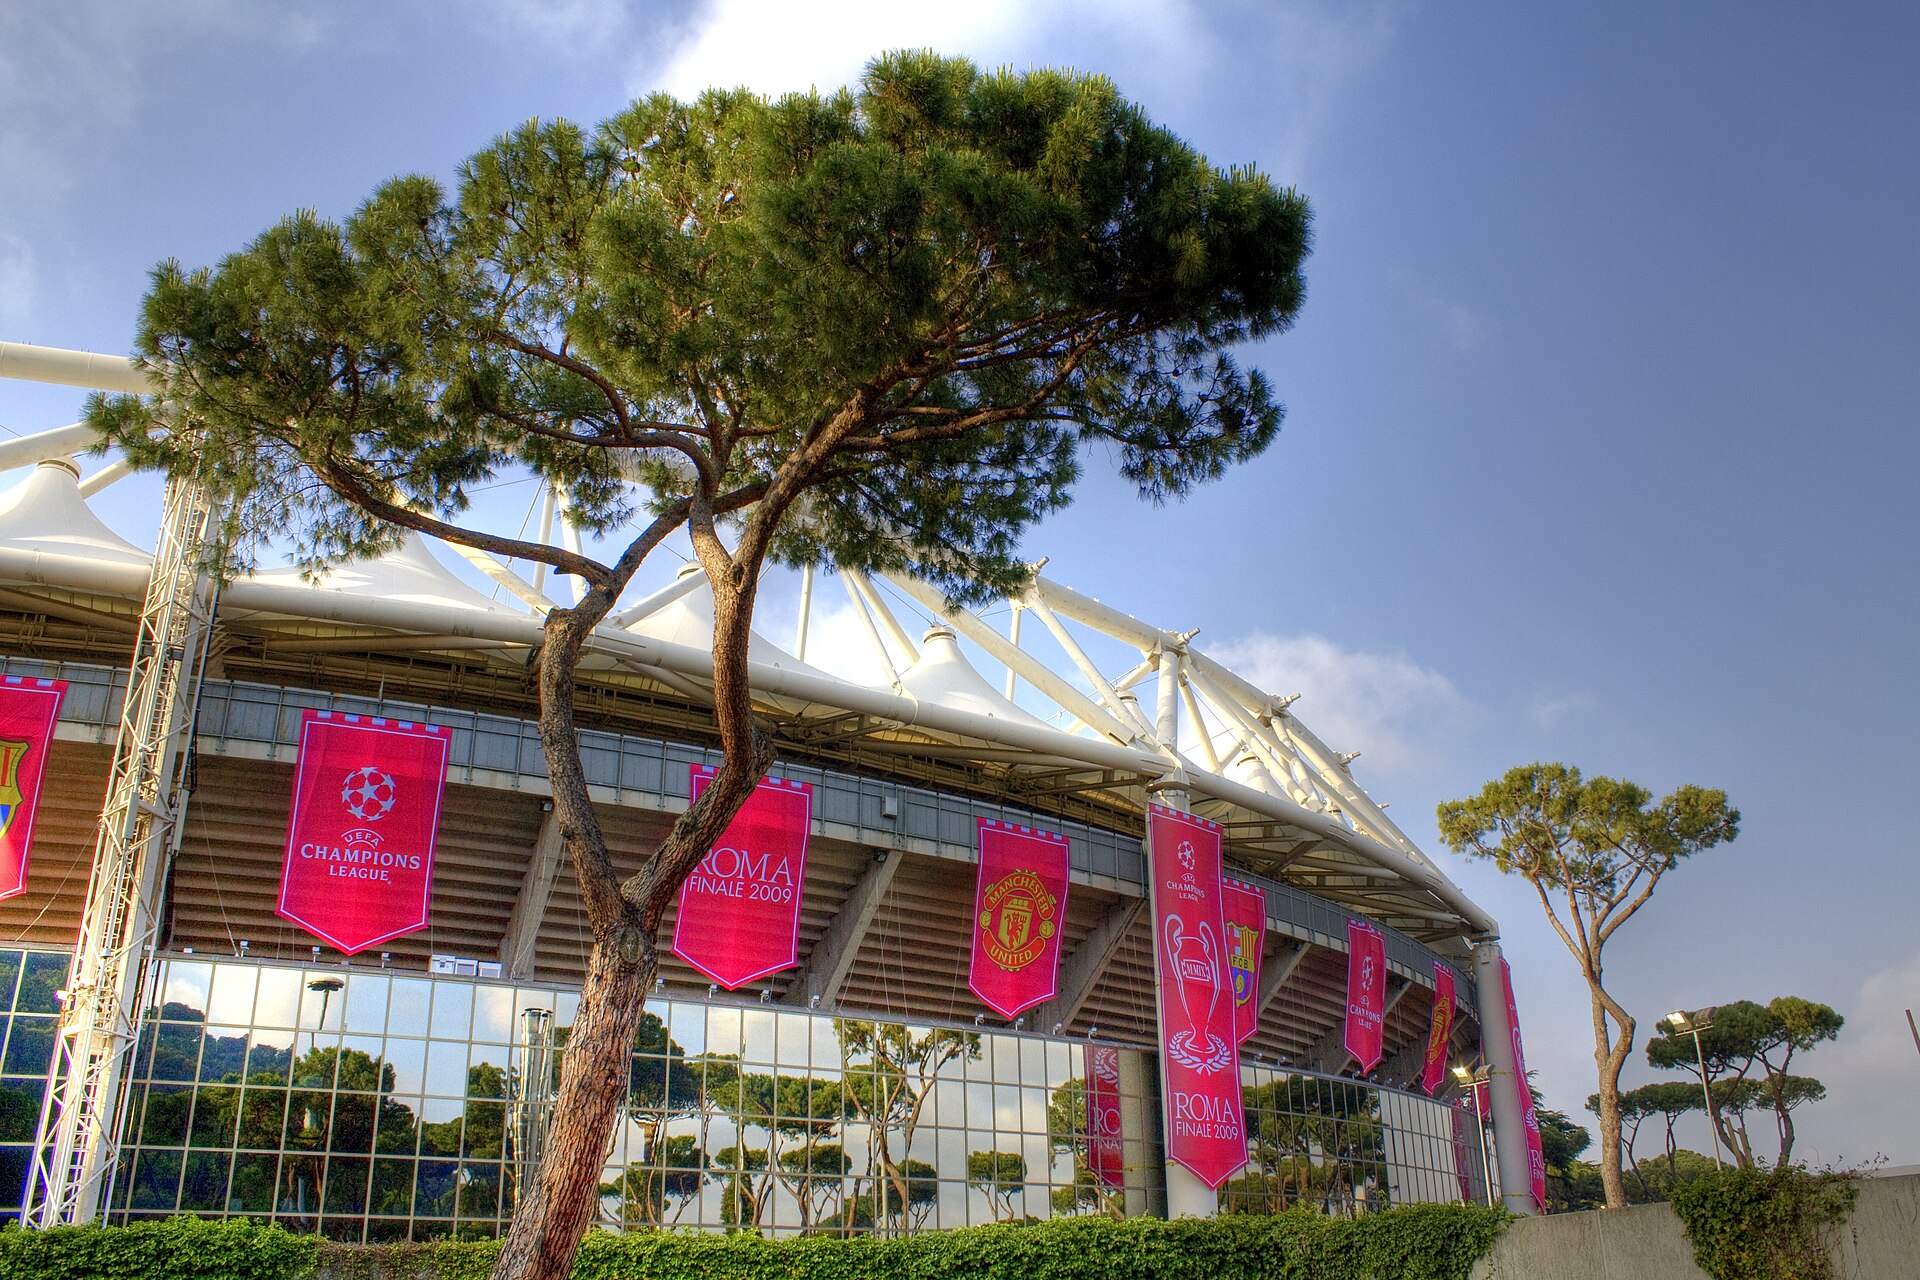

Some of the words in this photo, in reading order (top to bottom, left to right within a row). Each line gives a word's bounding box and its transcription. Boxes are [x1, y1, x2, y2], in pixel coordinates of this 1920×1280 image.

[344, 831, 380, 847] UEFA
[301, 843, 421, 870] CHAMPIONS
[692, 847, 794, 887] ROMA
[329, 864, 389, 881] LEAGUE
[689, 875, 745, 898] FINALE
[749, 883, 792, 904] 2009
[989, 876, 1049, 913] MANCHESTER
[990, 944, 1033, 965] UNITED
[1232, 955, 1249, 969] FCB
[1350, 1003, 1381, 1024] CHAMONS
[1174, 1092, 1238, 1124] ROMA
[1176, 1121, 1212, 1138] FINALE
[1214, 1124, 1239, 1140] 2009
